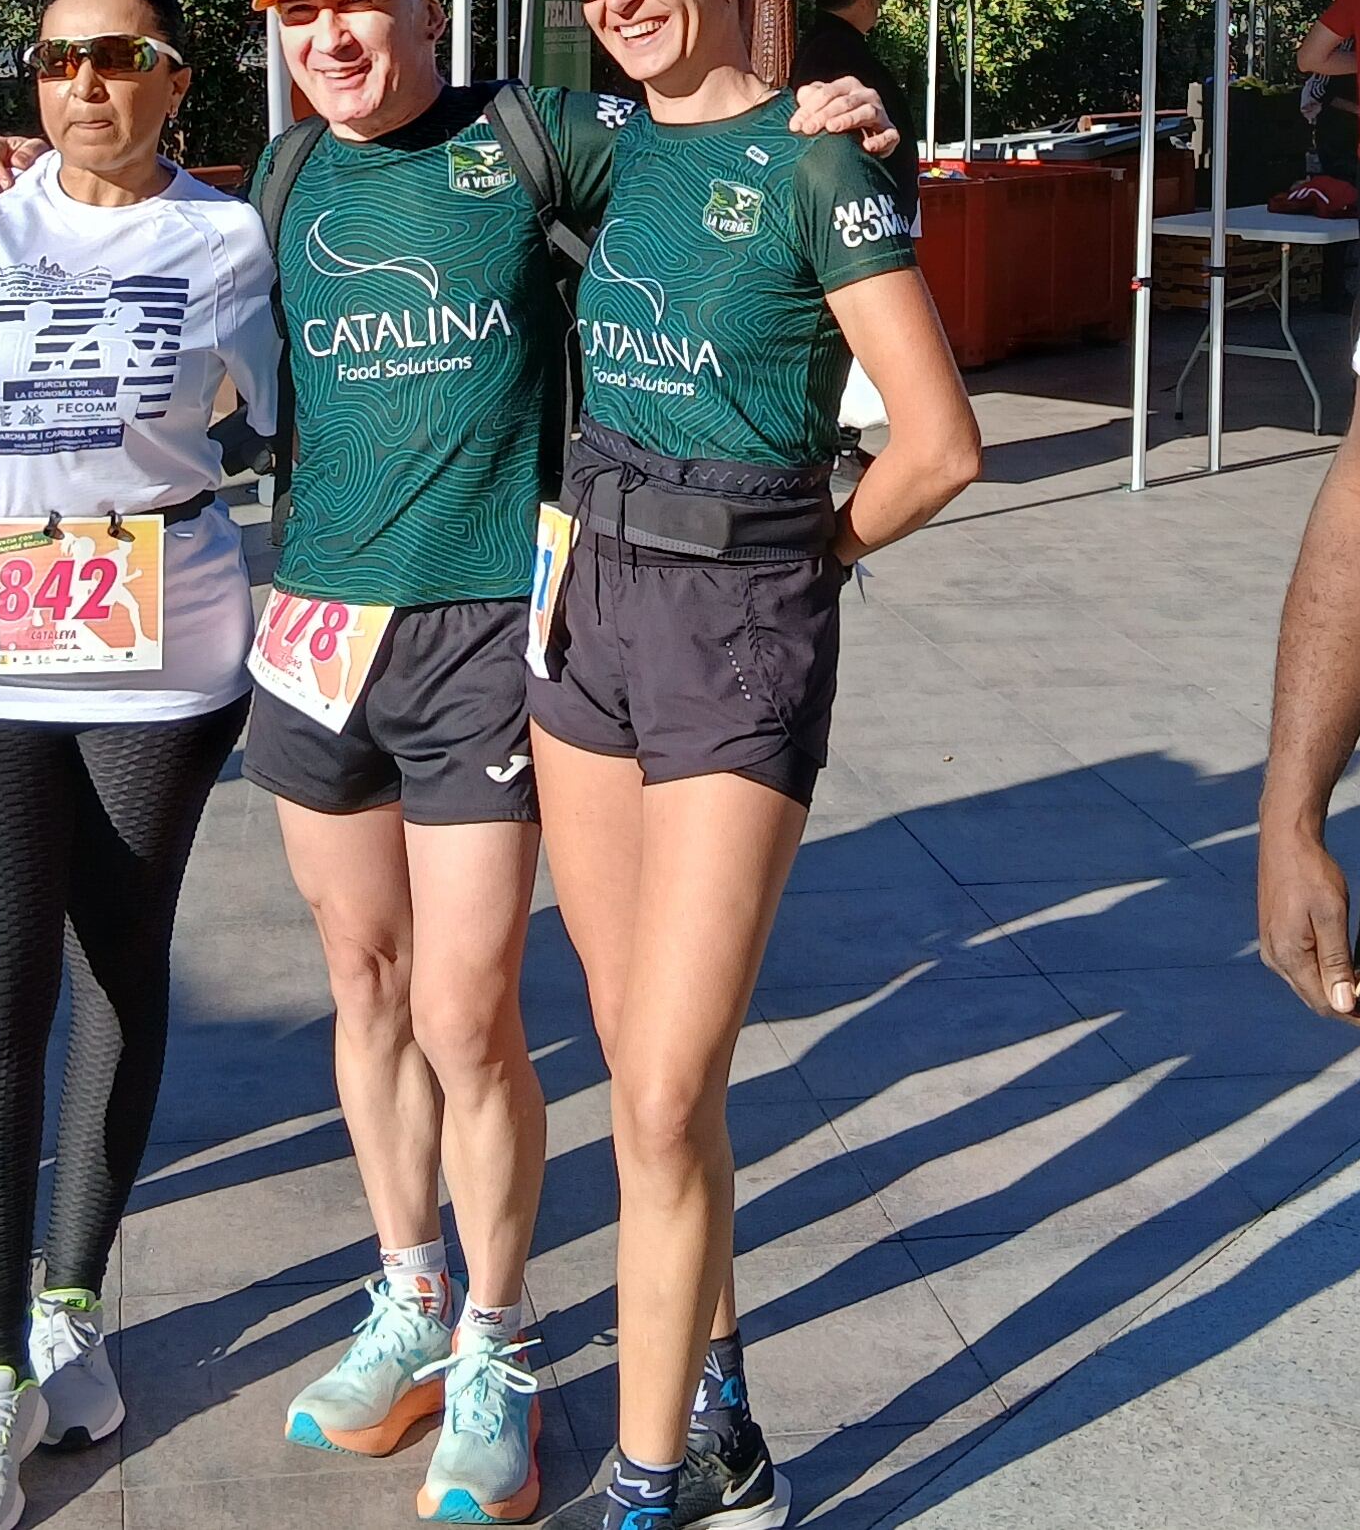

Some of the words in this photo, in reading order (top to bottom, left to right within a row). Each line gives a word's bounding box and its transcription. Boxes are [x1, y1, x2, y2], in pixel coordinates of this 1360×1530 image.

[456, 177, 471, 189] LA
[472, 172, 511, 189] VERDE
[707, 213, 719, 228] LA
[719, 217, 753, 233] VERDE
[303, 299, 512, 357] CATALINA
[577, 318, 723, 378] CATALINA
[338, 360, 381, 382] Food
[385, 355, 472, 379] Solutions
[592, 366, 627, 387] Food
[34, 380, 68, 389] MURCIA
[69, 379, 89, 388] CON
[56, 401, 118, 414] FECOAM
